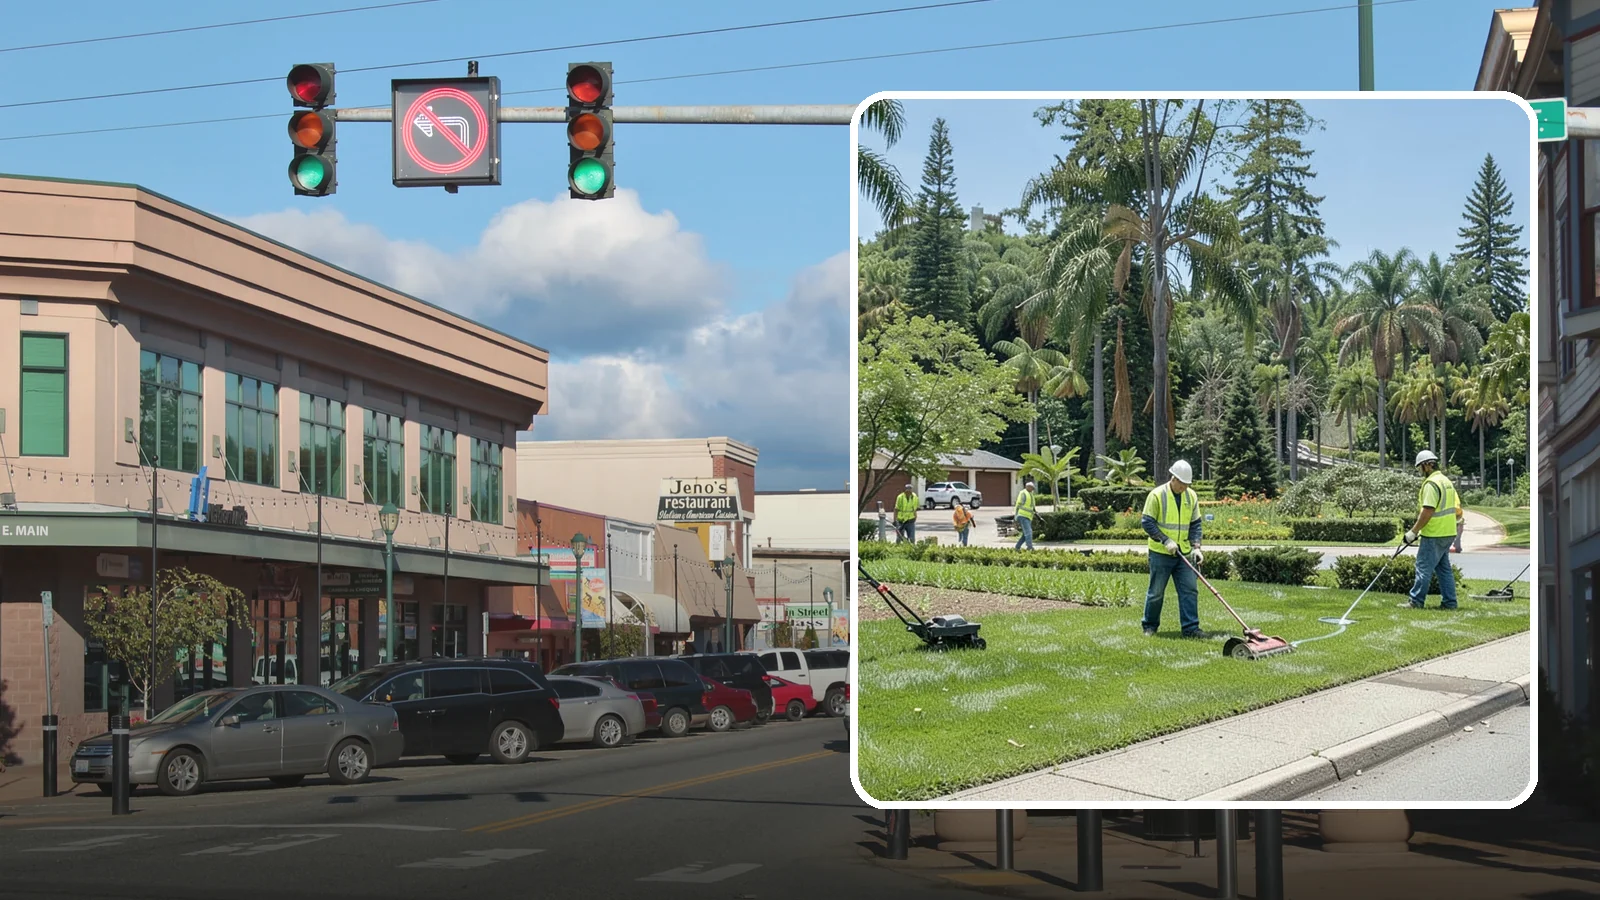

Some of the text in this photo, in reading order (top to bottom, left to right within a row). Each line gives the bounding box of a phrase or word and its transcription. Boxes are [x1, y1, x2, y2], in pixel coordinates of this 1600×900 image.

[669, 479, 728, 495] Jeno's
[664, 496, 731, 509] restaurant
[658, 509, 682, 520] Italian
[686, 509, 715, 520] American
[715, 509, 738, 520] Cuisine
[2, 525, 49, 536] E. MAIN
[797, 608, 829, 616] Street
[791, 619, 824, 627] lass
